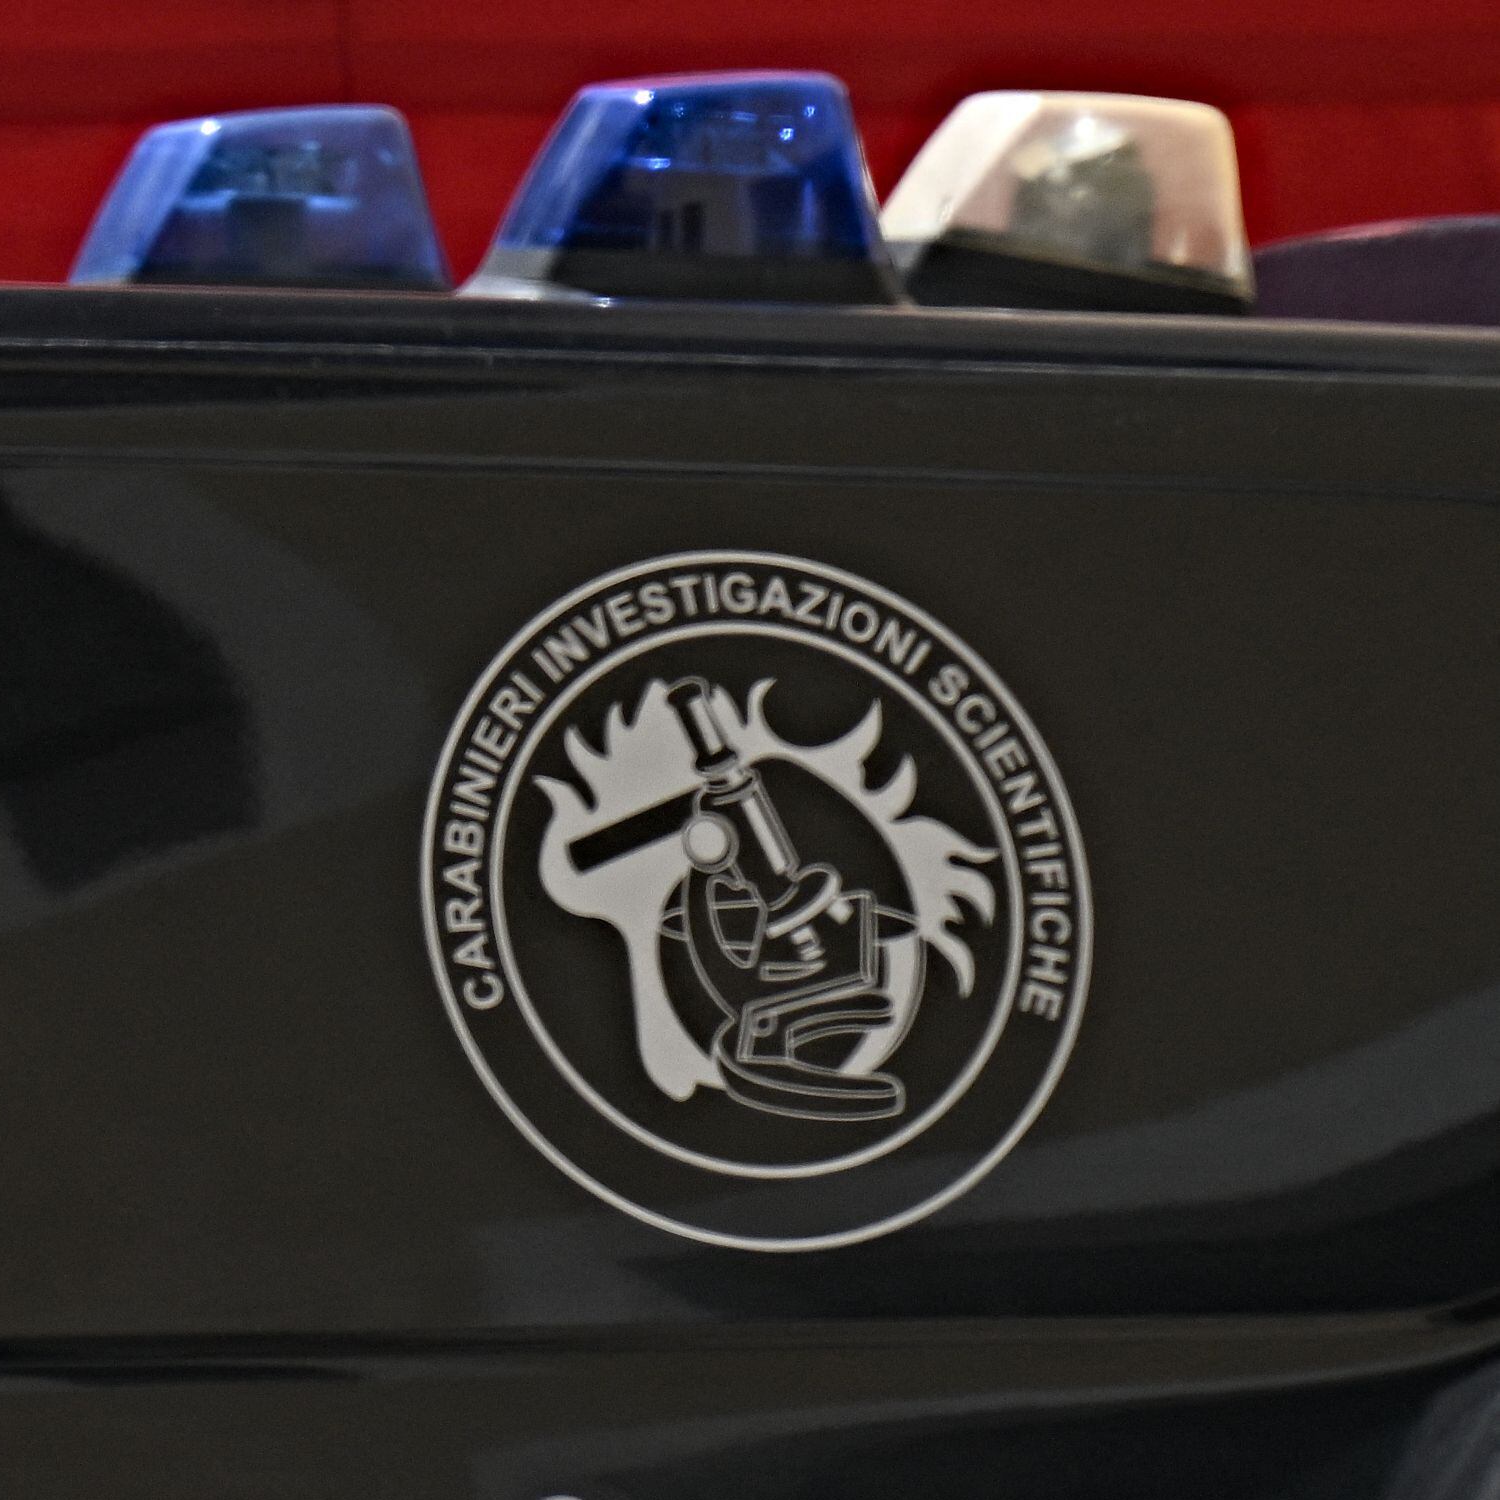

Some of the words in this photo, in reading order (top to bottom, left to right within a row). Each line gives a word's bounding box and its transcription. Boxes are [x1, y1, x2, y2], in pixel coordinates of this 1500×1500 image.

[441, 675, 543, 1011] CARABINIERI
[535, 571, 932, 681] INVESTIGAZIONI
[927, 665, 1073, 1022] SCIENTIFICHE
